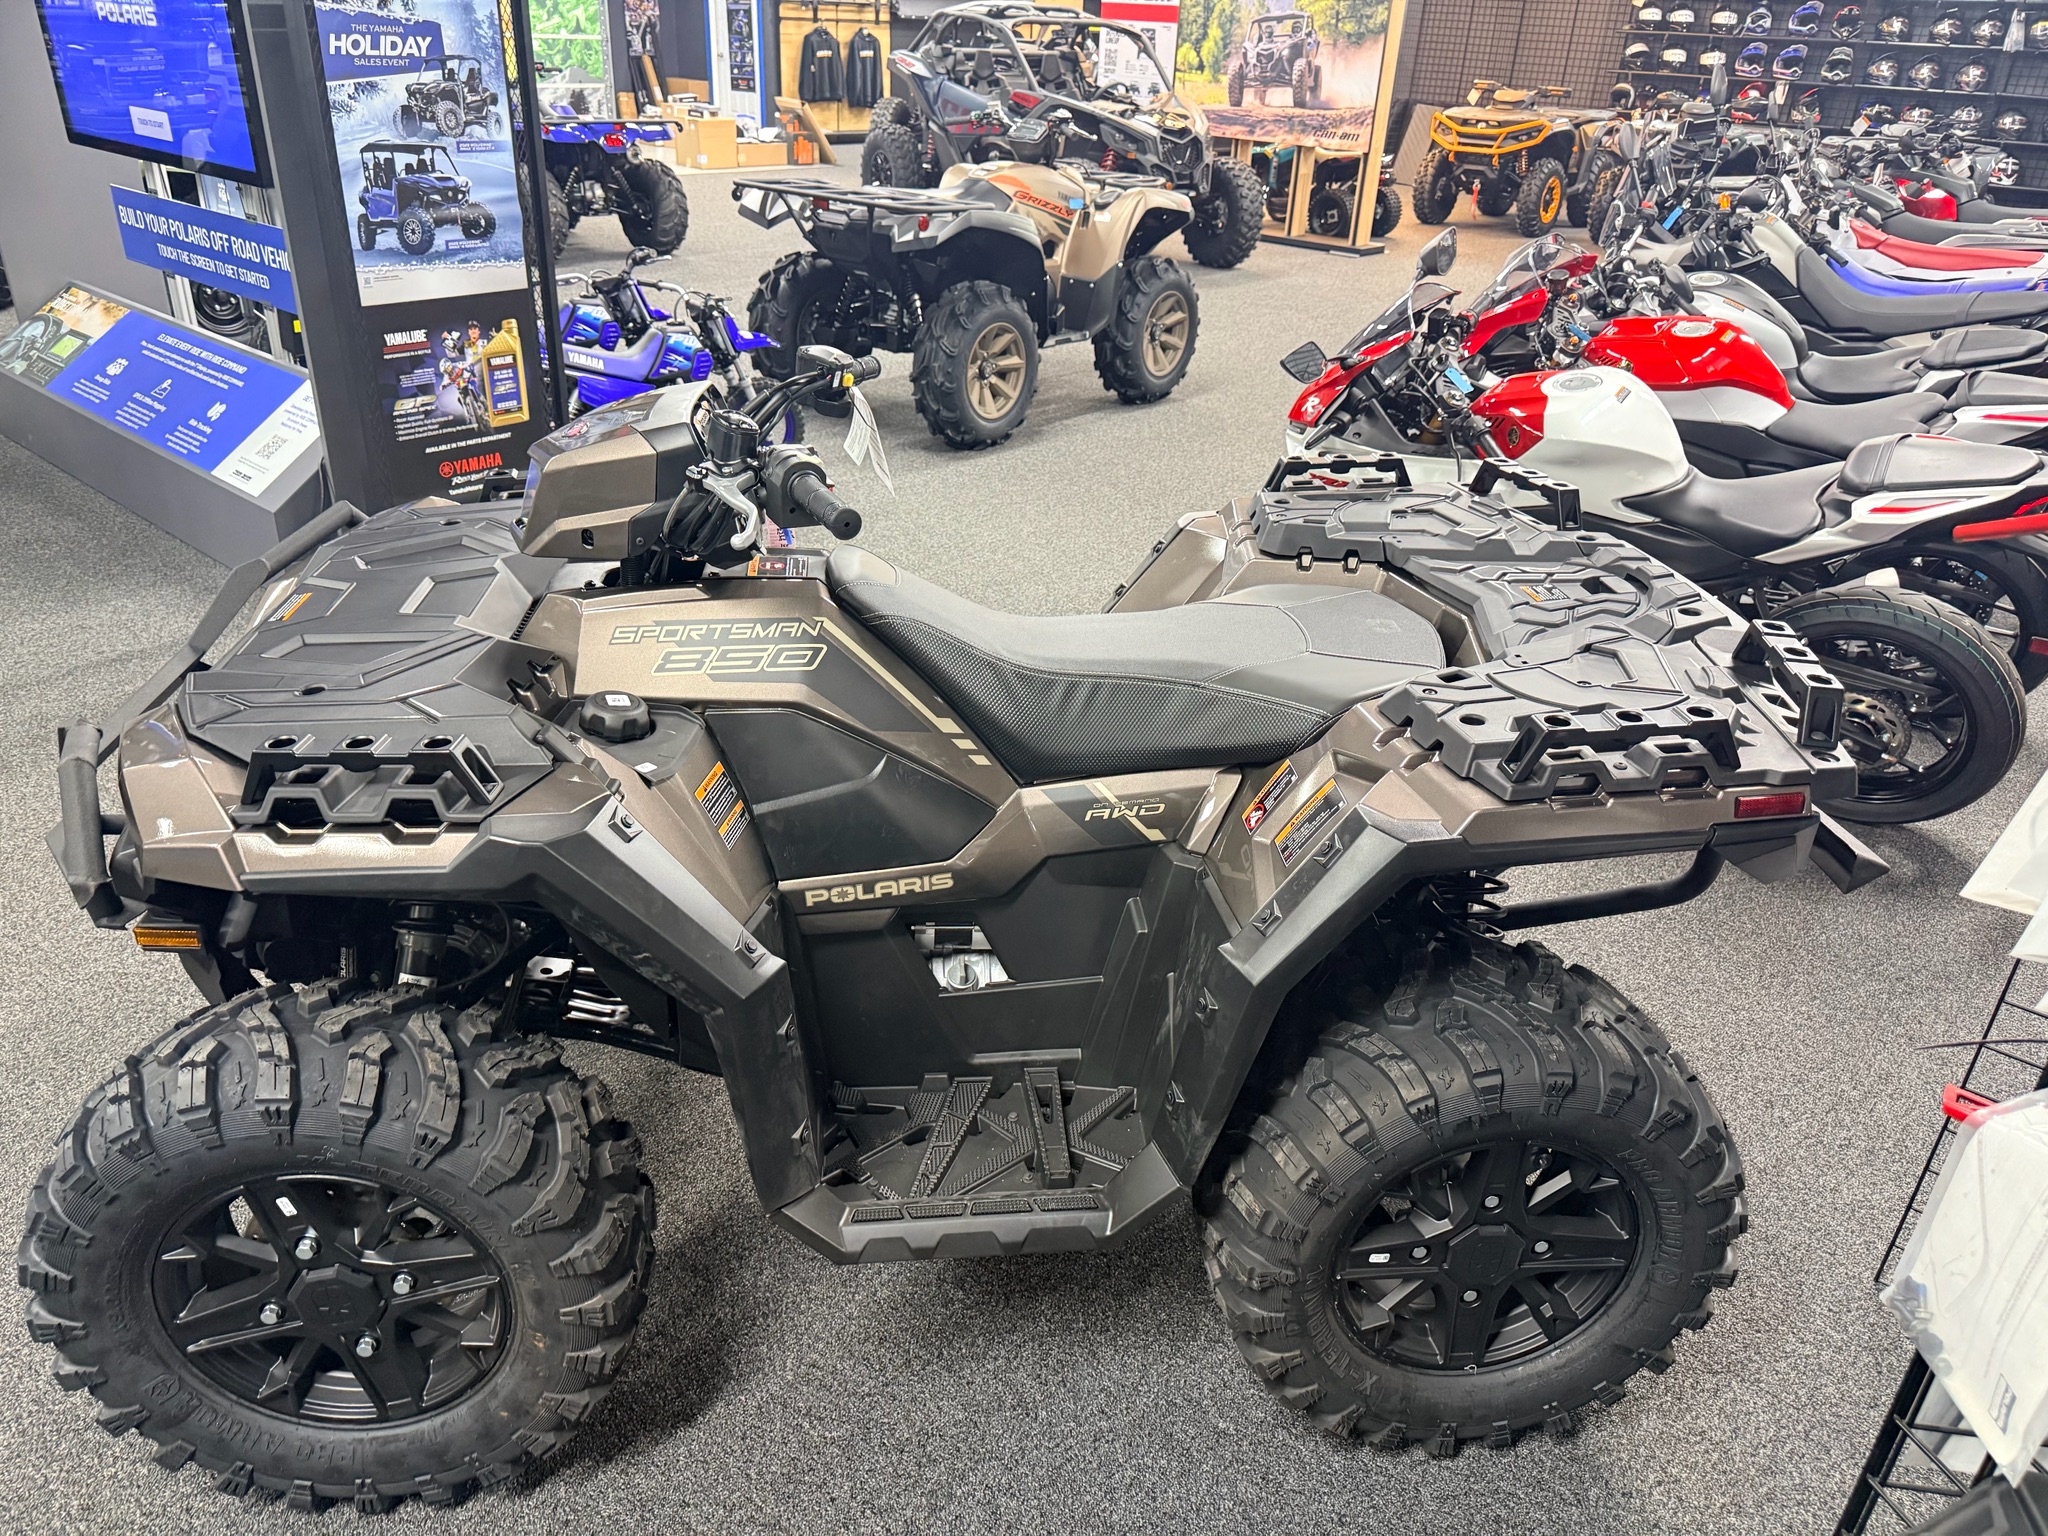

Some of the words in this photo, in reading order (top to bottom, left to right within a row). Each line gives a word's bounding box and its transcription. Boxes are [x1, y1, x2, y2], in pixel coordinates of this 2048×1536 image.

[95, 1, 157, 26] POLARIS
[350, 24, 368, 32] THE
[369, 24, 404, 33] YAMAHA
[329, 33, 433, 57] HOLIDAY
[354, 57, 381, 66] SALES
[383, 59, 410, 67] EVENT
[1013, 190, 1075, 218] GRIZZLY
[118, 205, 144, 229] BUILD
[144, 213, 169, 238] YOUR
[170, 219, 210, 249] POLARIS
[210, 230, 230, 254] OFF
[231, 236, 260, 263] ROAD
[156, 243, 177, 261] TOUCH
[177, 248, 191, 265] THE
[190, 253, 216, 272] SCREEN
[214, 261, 226, 276] TO
[225, 264, 239, 280] GET
[239, 268, 270, 290] STARTED
[383, 329, 428, 346] YAMALUBE
[567, 351, 605, 370] YAMAHA
[394, 395, 437, 411] GP
[425, 443, 451, 454] AVAILABLE
[457, 440, 466, 448] THE
[467, 438, 481, 446] PARTS
[482, 432, 512, 443] DEPARTMENT
[453, 452, 503, 475] YAMAHA
[610, 622, 823, 645] SPORTSMAN
[651, 643, 828, 676] 850
[1085, 803, 1166, 821] AWD
[1295, 796, 1319, 821] WARNING
[805, 872, 955, 907] POLARIS
[1304, 1264, 1380, 1396] X-TERRAIN
